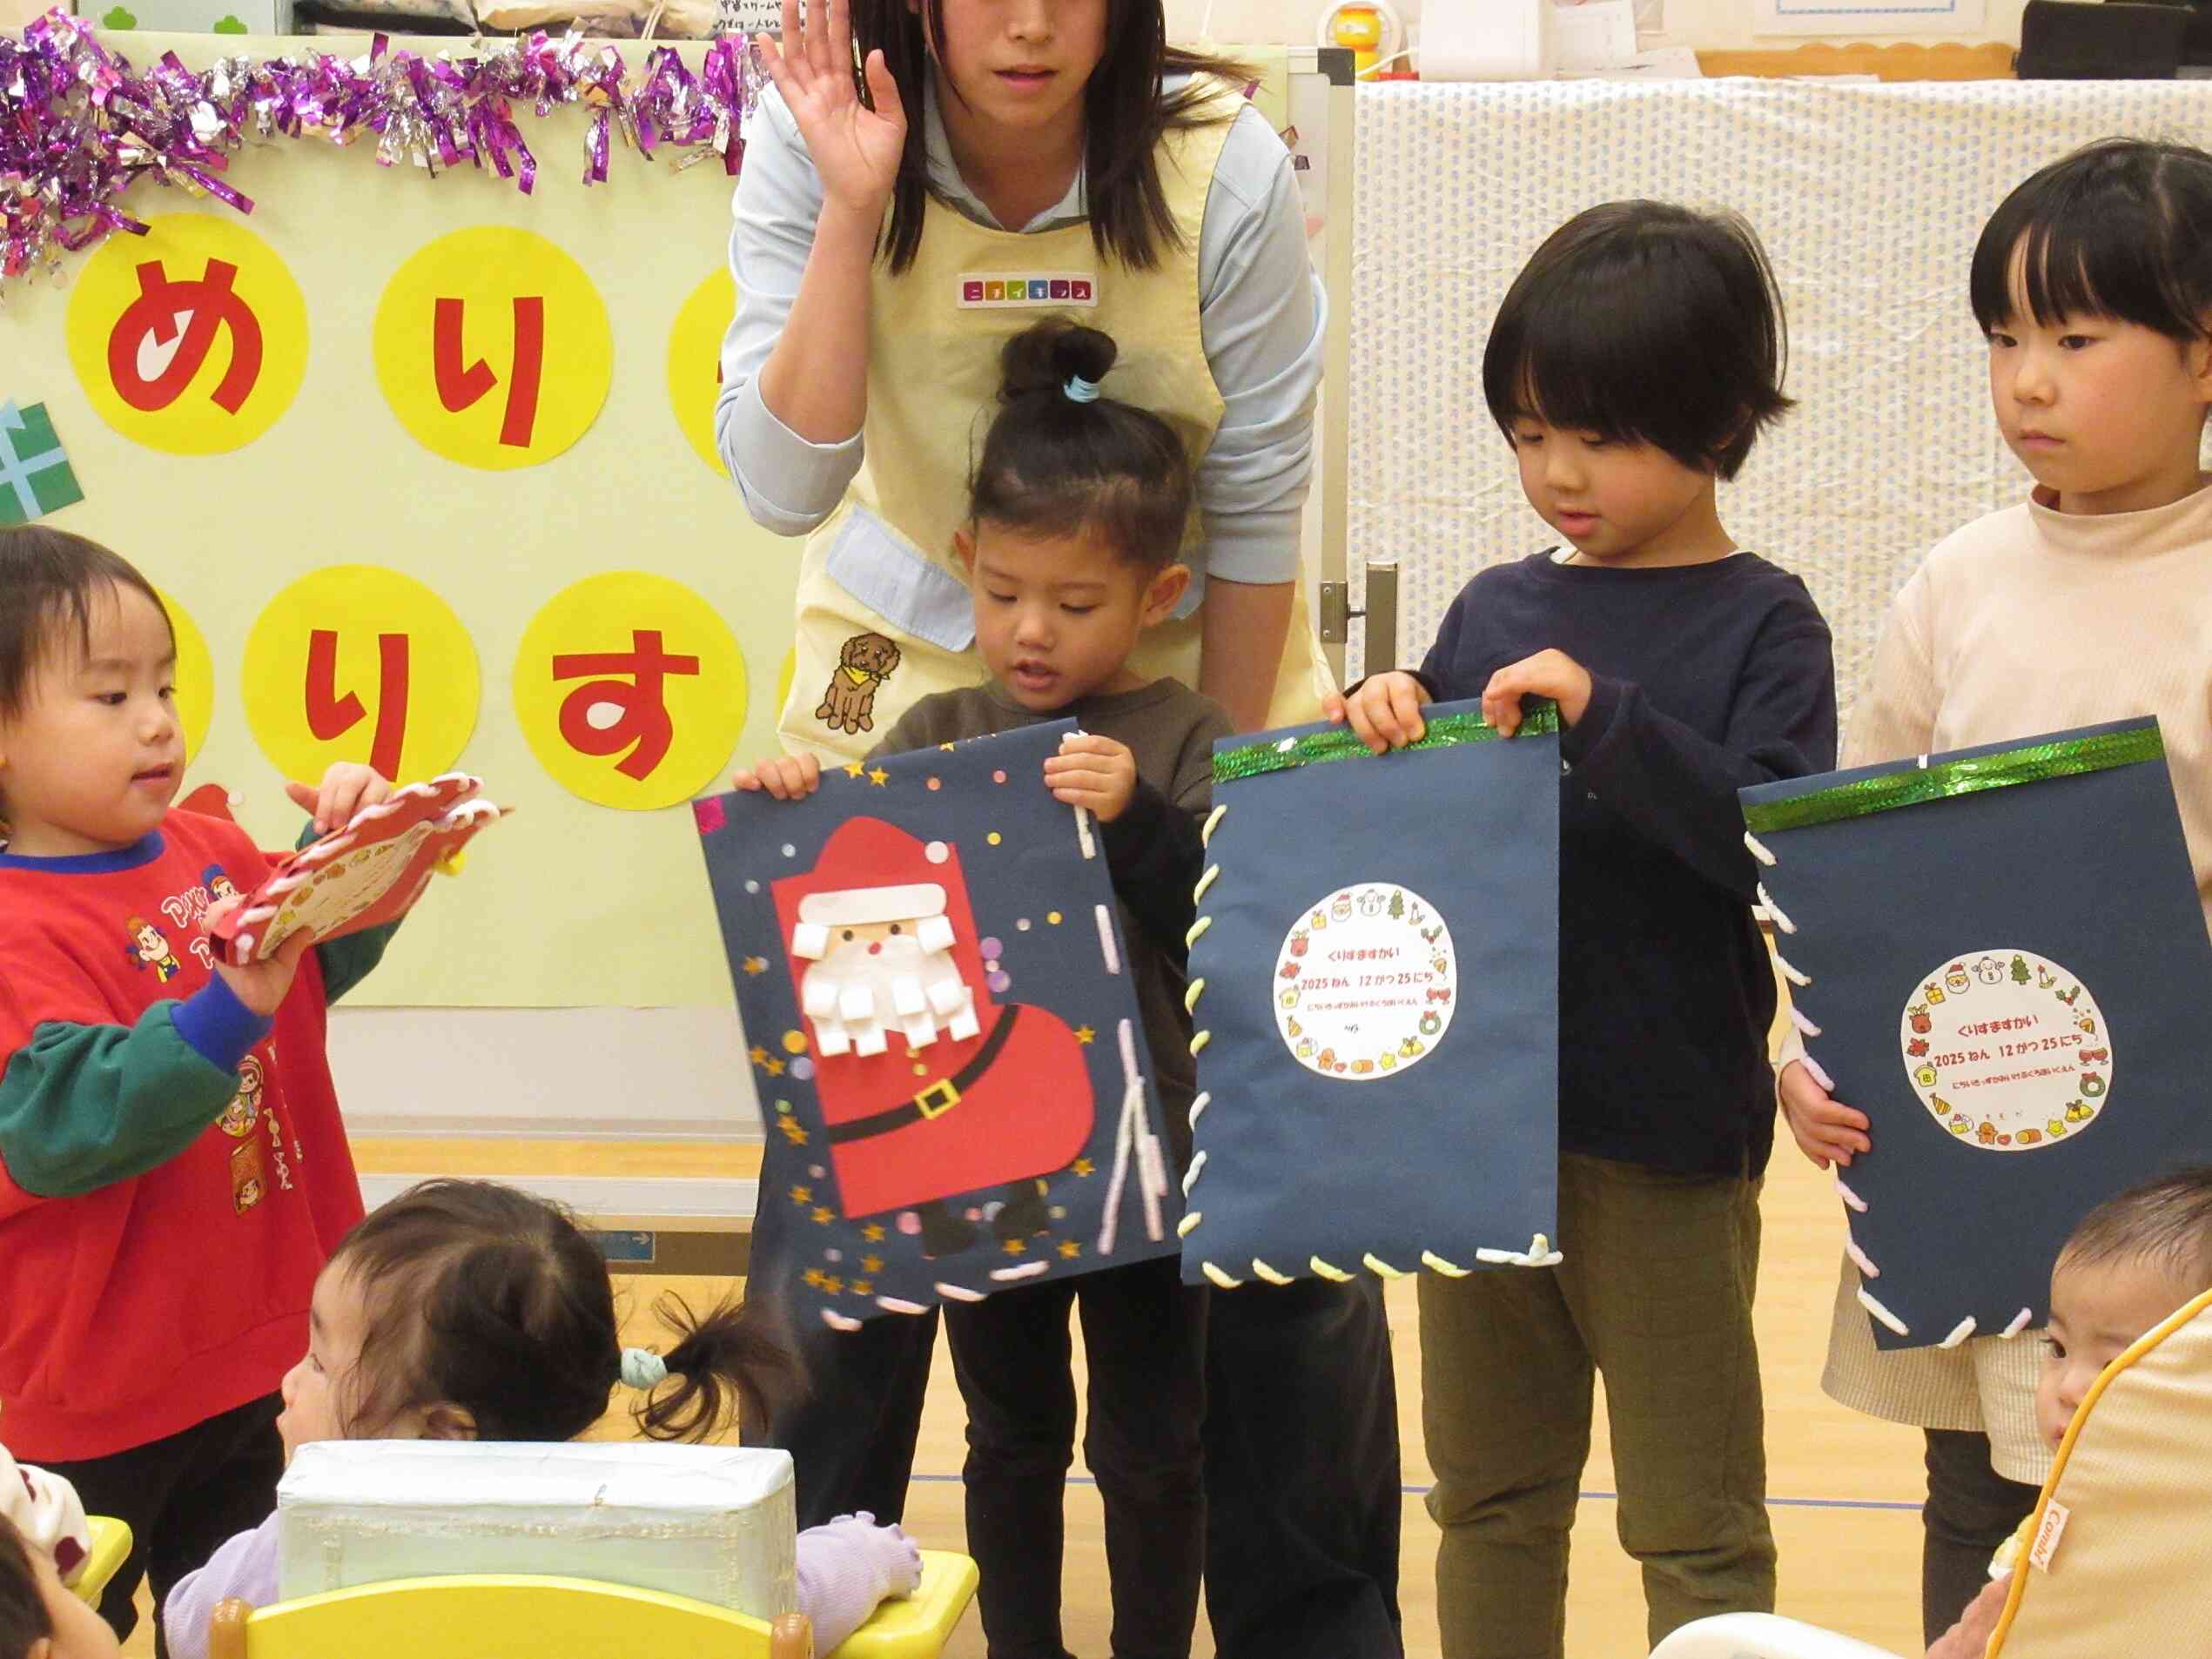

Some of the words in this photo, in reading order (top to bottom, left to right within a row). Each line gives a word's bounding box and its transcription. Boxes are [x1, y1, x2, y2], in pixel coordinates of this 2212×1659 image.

[1301, 977, 1328, 991] 2025
[1359, 975, 1372, 986] 12
[1397, 972, 1411, 984] 25
[1413, 971, 1434, 984] にち
[1958, 1015, 2040, 1038] くりすますかい
[1934, 1051, 1966, 1067] 2025
[1969, 1049, 1991, 1062] ねん
[1999, 1044, 2014, 1058] 12
[2017, 1041, 2039, 1055] がつ
[2041, 1037, 2058, 1051] 25
[2060, 1033, 2083, 1047] にち
[2034, 1509, 2061, 1566] Combi
